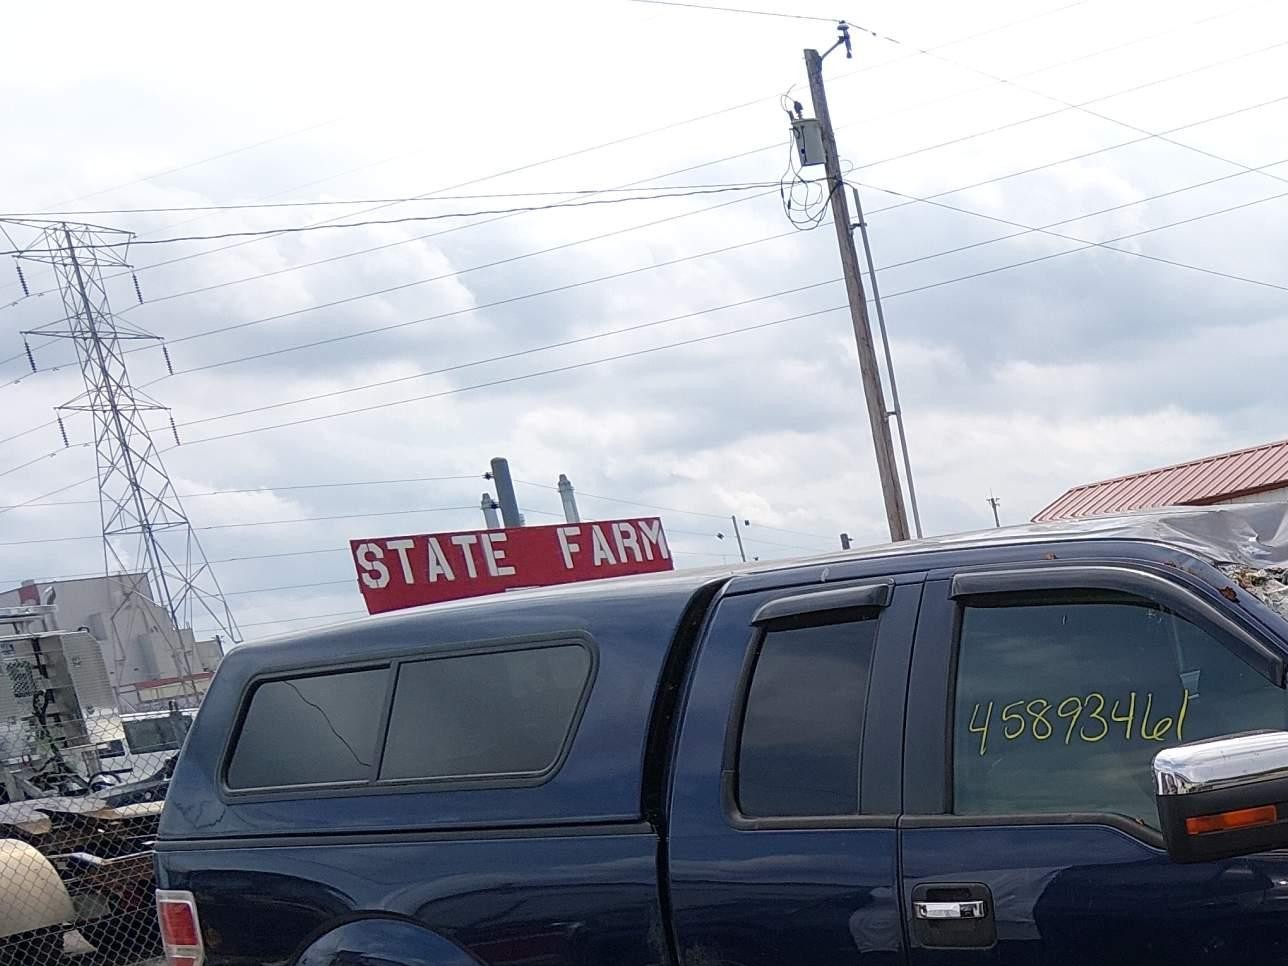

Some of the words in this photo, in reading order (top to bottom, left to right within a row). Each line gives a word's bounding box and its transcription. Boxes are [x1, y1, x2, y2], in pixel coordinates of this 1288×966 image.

[355, 532, 516, 589] STATE
[556, 518, 669, 569] FARM
[968, 688, 1189, 756] 45893461
